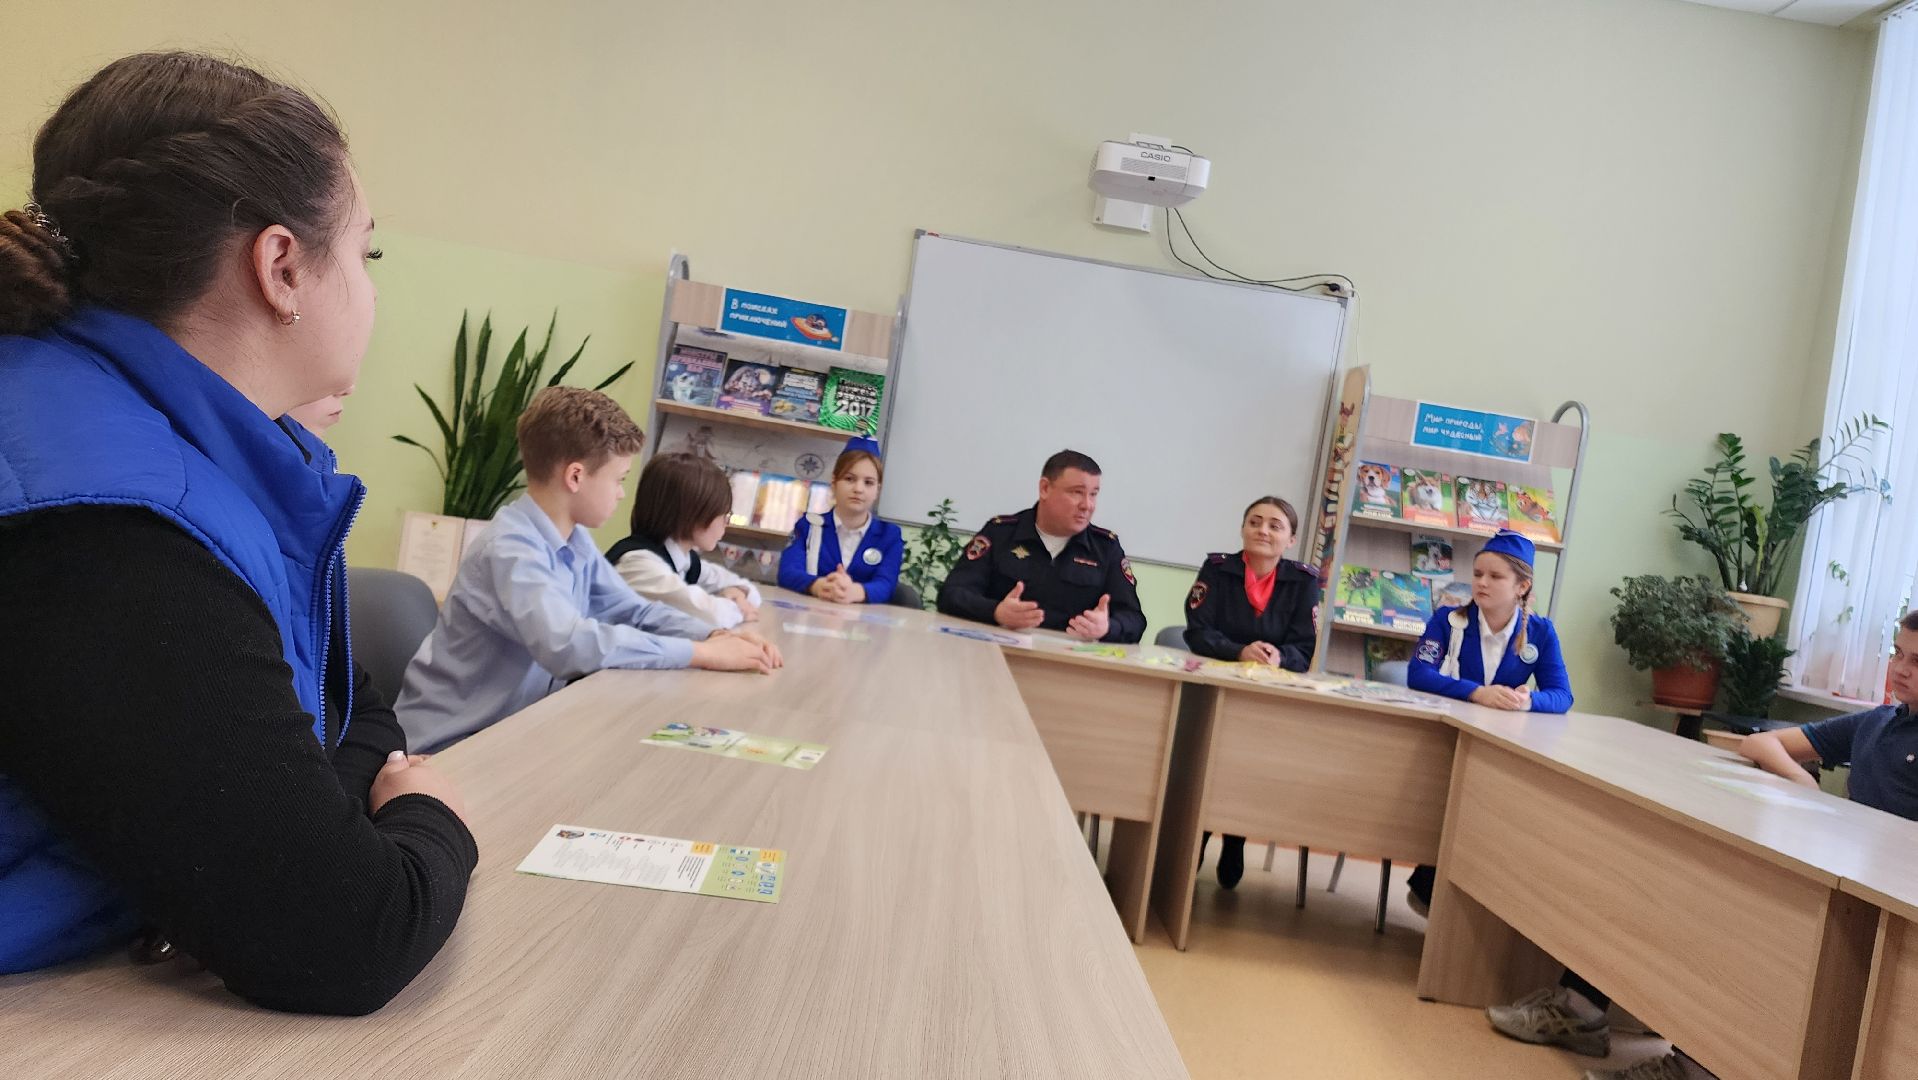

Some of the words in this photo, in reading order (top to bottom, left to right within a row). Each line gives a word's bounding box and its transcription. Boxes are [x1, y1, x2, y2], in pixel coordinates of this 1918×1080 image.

[1140, 151, 1171, 162] CASIO
[730, 298, 739, 310] В
[834, 400, 876, 416] 2017
